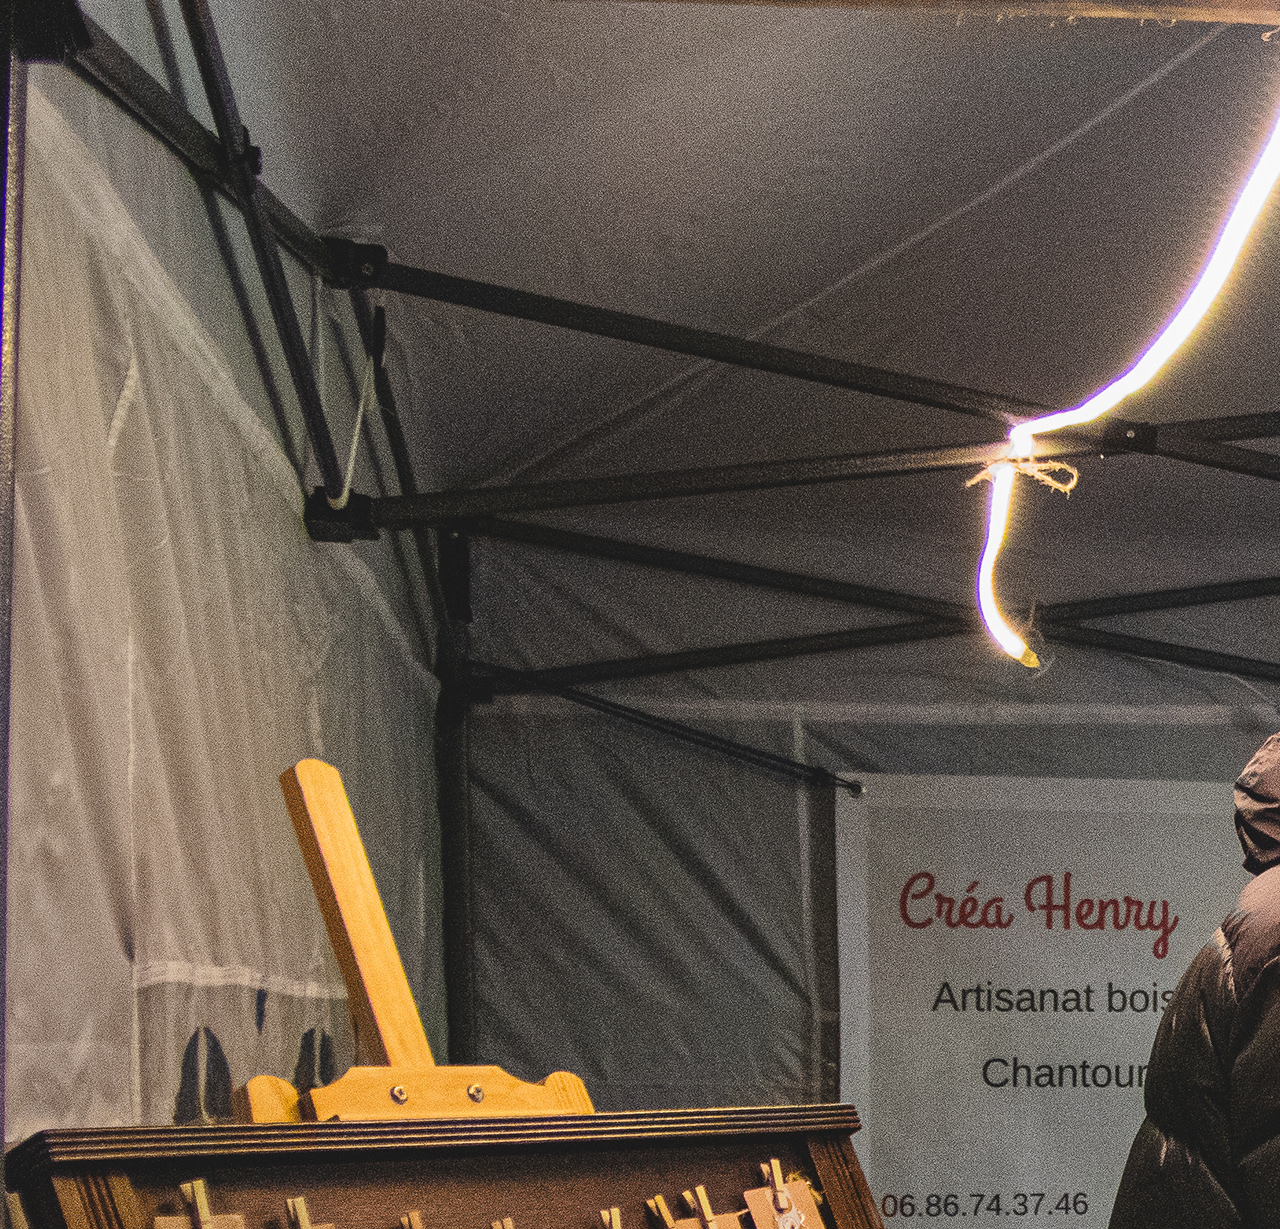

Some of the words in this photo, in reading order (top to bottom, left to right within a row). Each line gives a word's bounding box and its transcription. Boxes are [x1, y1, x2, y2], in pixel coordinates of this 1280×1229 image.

[901, 872, 1014, 930] Créa
[1024, 871, 1180, 960] Henry
[932, 980, 1096, 1013] Artisanat
[881, 1191, 1089, 1218] 06.86.74.37.46
